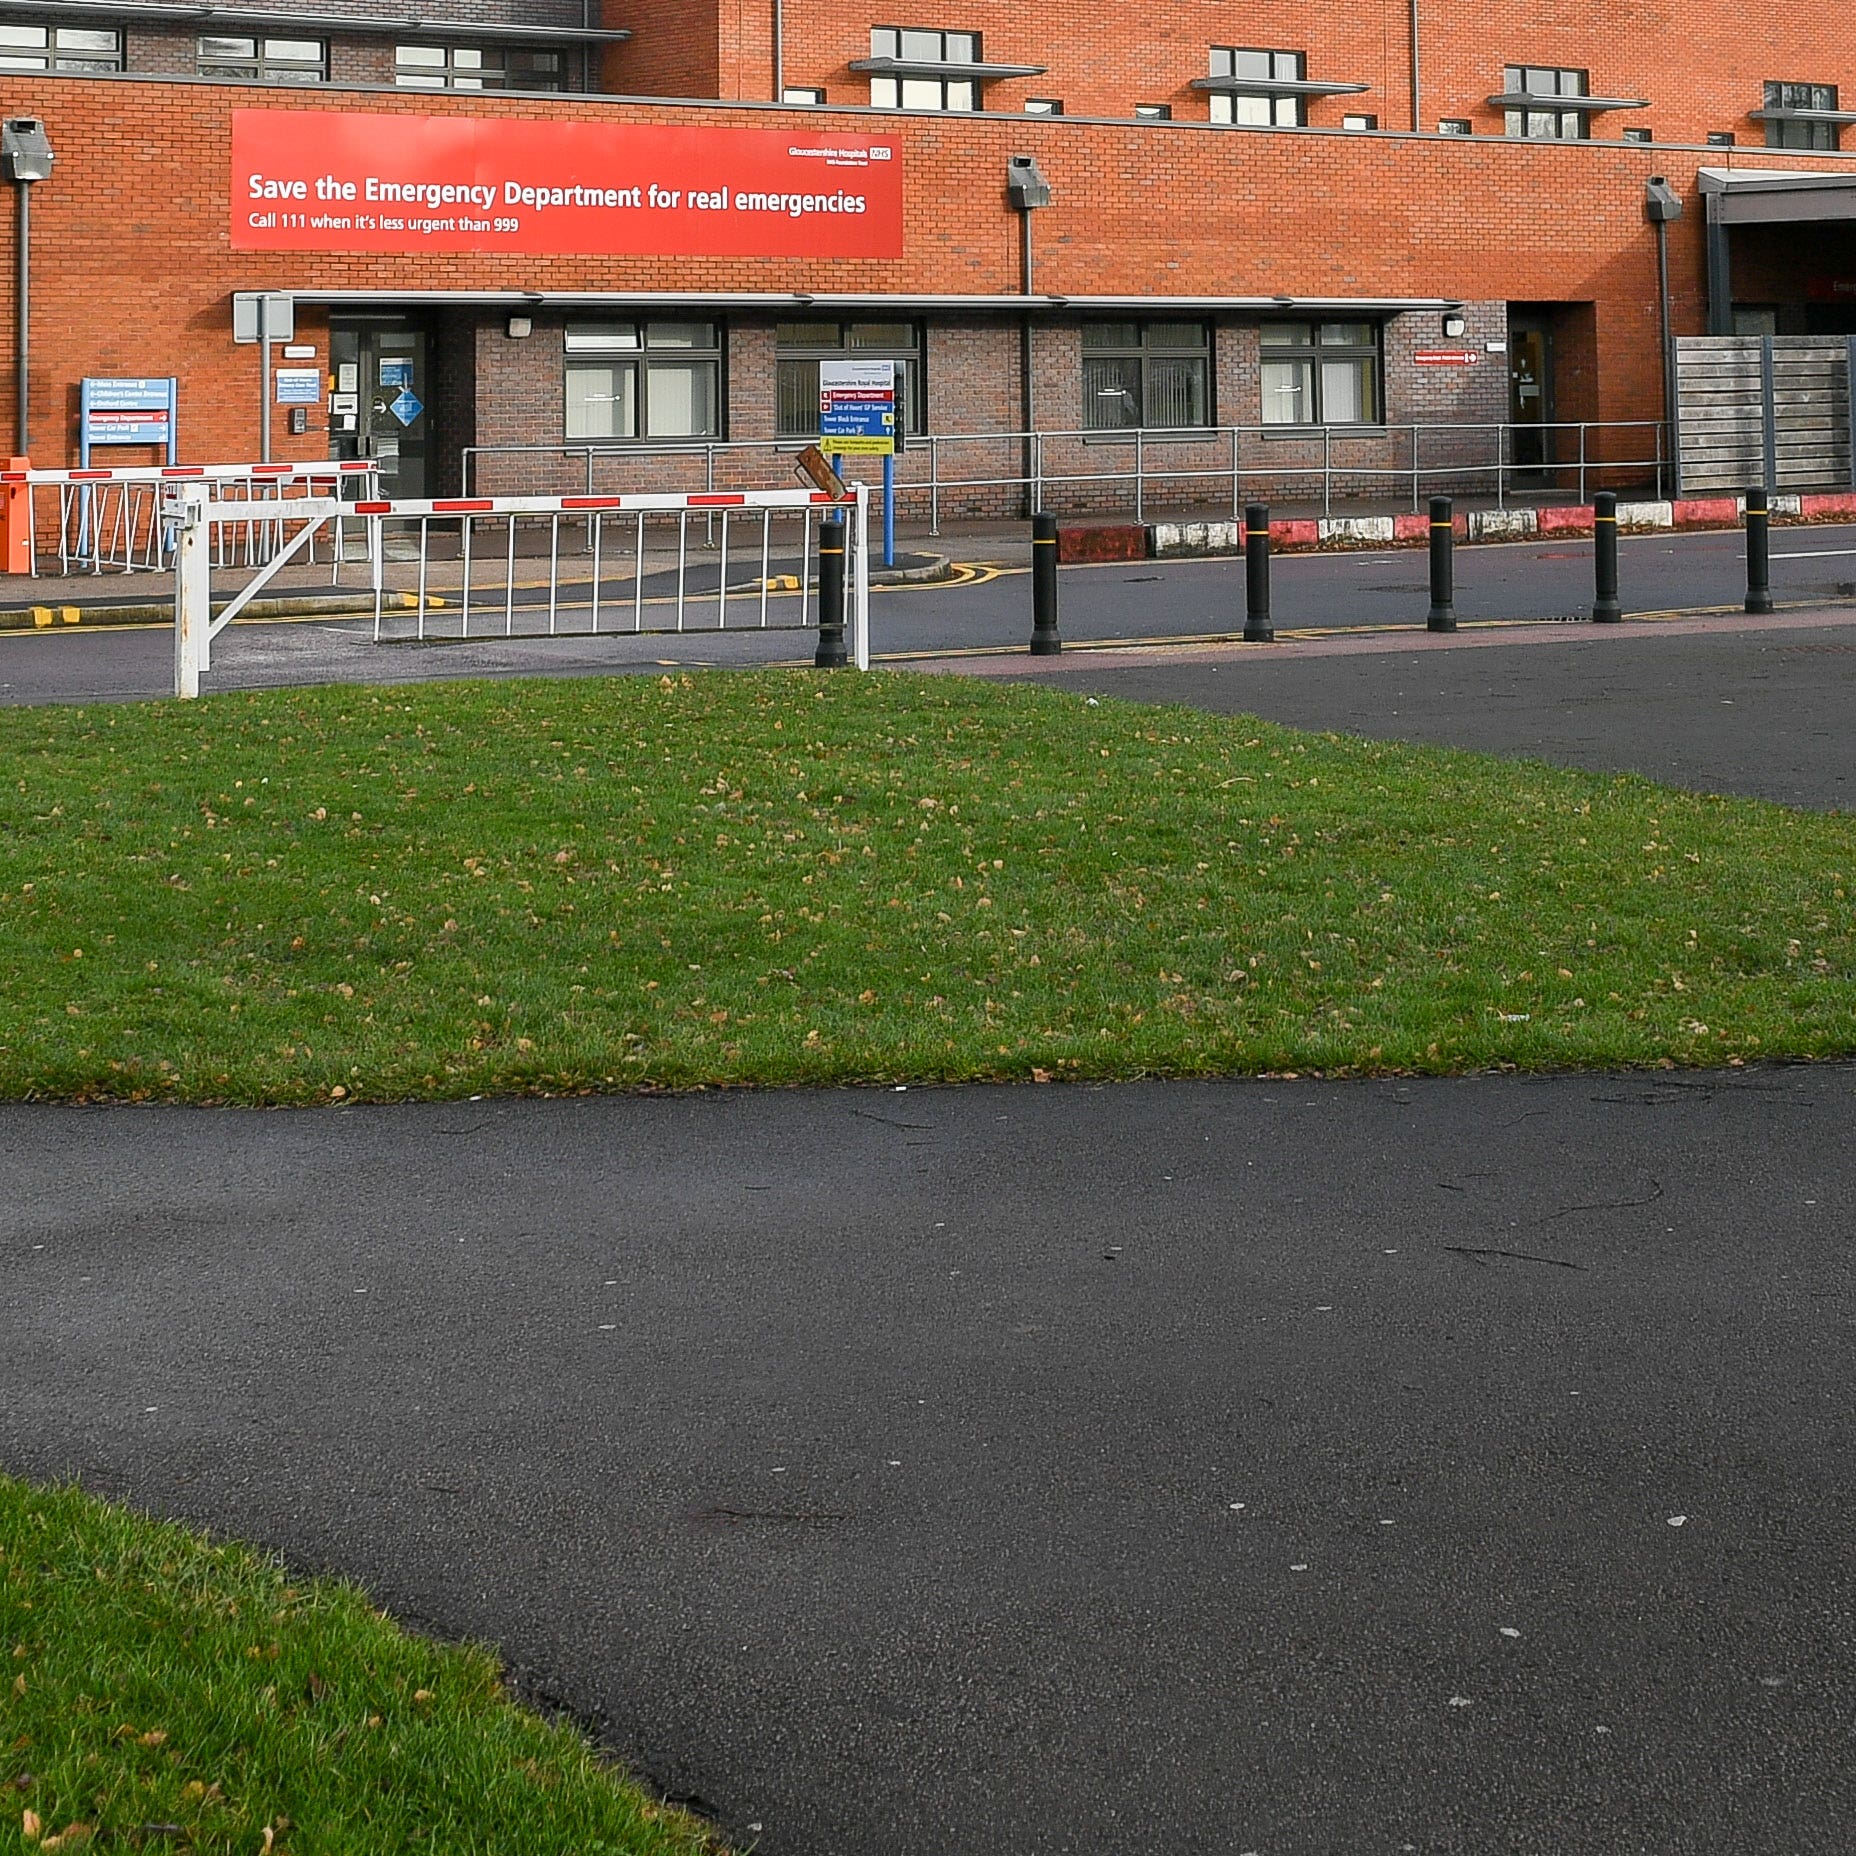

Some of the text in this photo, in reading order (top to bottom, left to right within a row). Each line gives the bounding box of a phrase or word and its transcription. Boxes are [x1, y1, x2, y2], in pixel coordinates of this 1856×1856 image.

[870, 147, 891, 159] NHS
[249, 174, 866, 217] Save the Emergency Department for real emergencies
[249, 212, 519, 235] Call 111 when it's less urgent than 999
[822, 379, 857, 387] Gloucestershire
[857, 379, 870, 387] Royal
[832, 392, 884, 400] Emergency Department
[88, 414, 154, 423] Emergency Department
